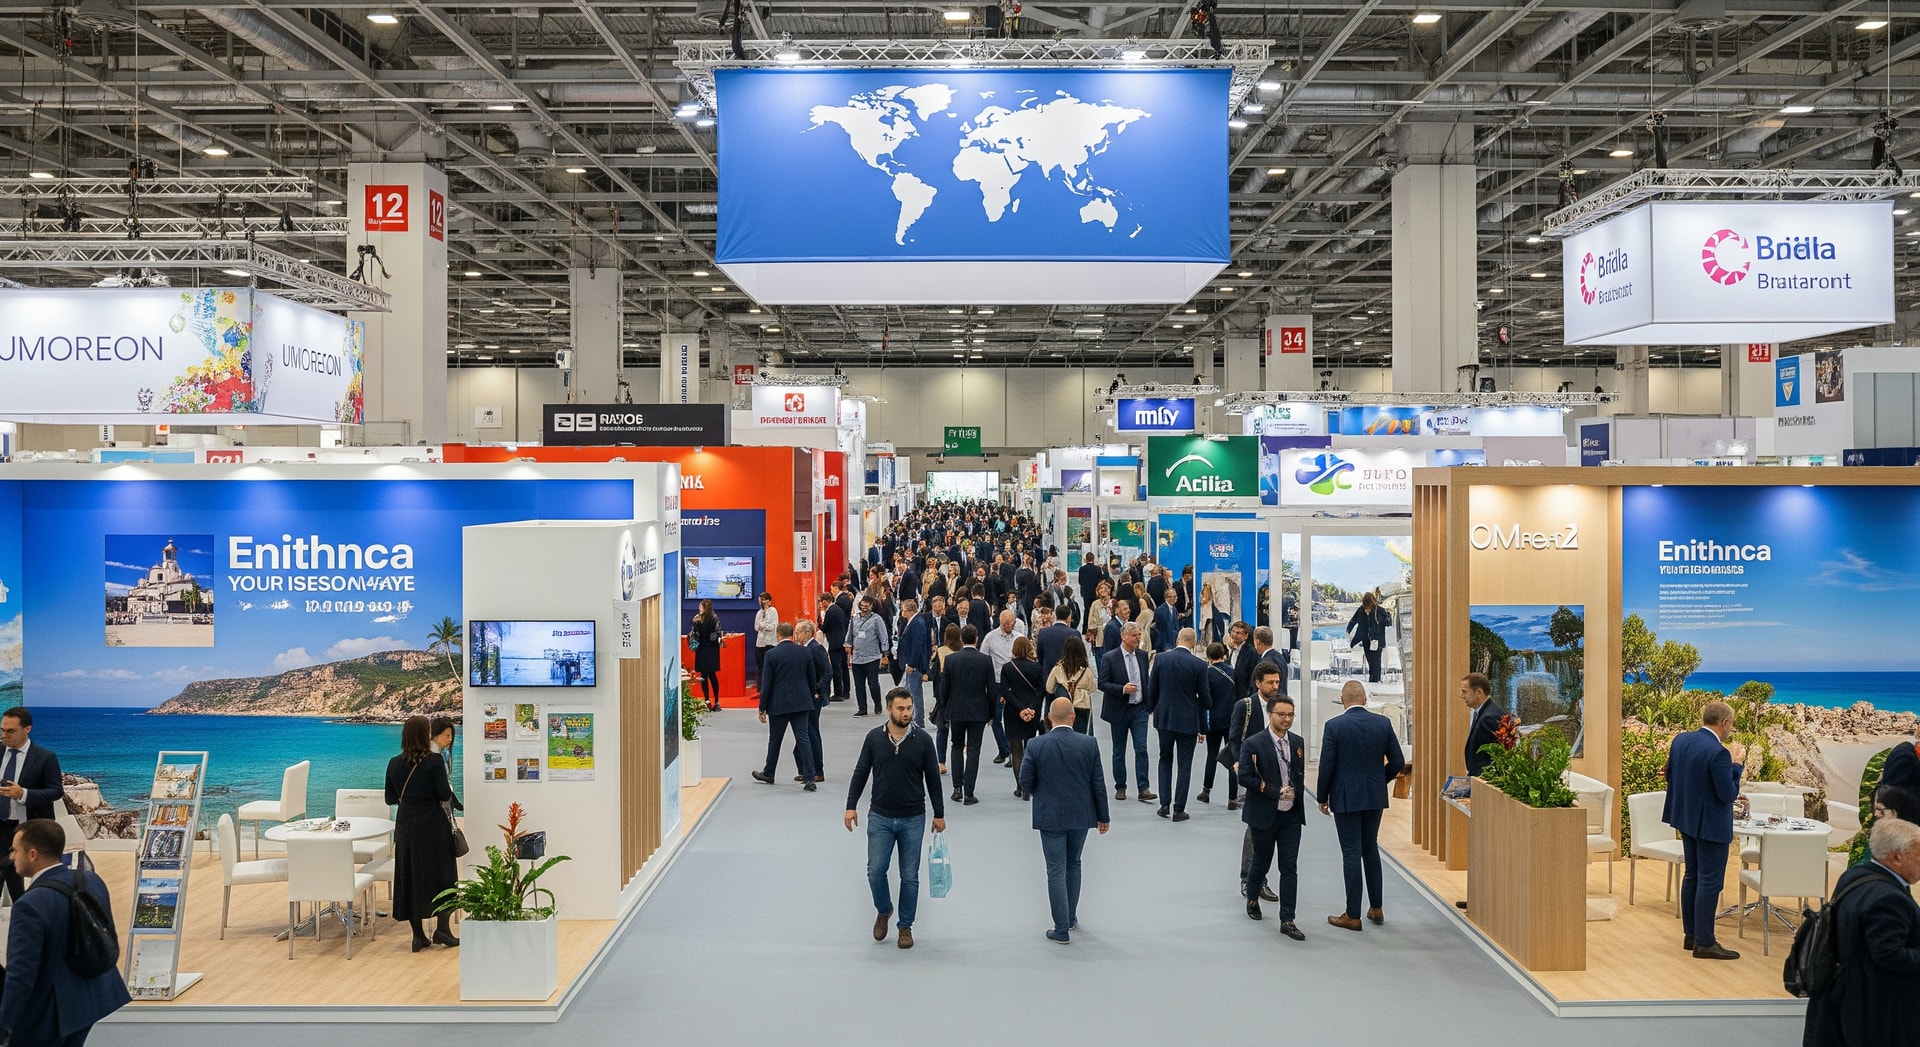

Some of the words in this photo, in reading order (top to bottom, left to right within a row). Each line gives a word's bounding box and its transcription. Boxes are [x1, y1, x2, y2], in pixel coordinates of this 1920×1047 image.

[372, 192, 403, 218] 12
[431, 198, 443, 228] 12
[229, 534, 413, 570] Enithnca
[1659, 539, 1771, 561] Enithnca
[228, 575, 283, 592] YOUR
